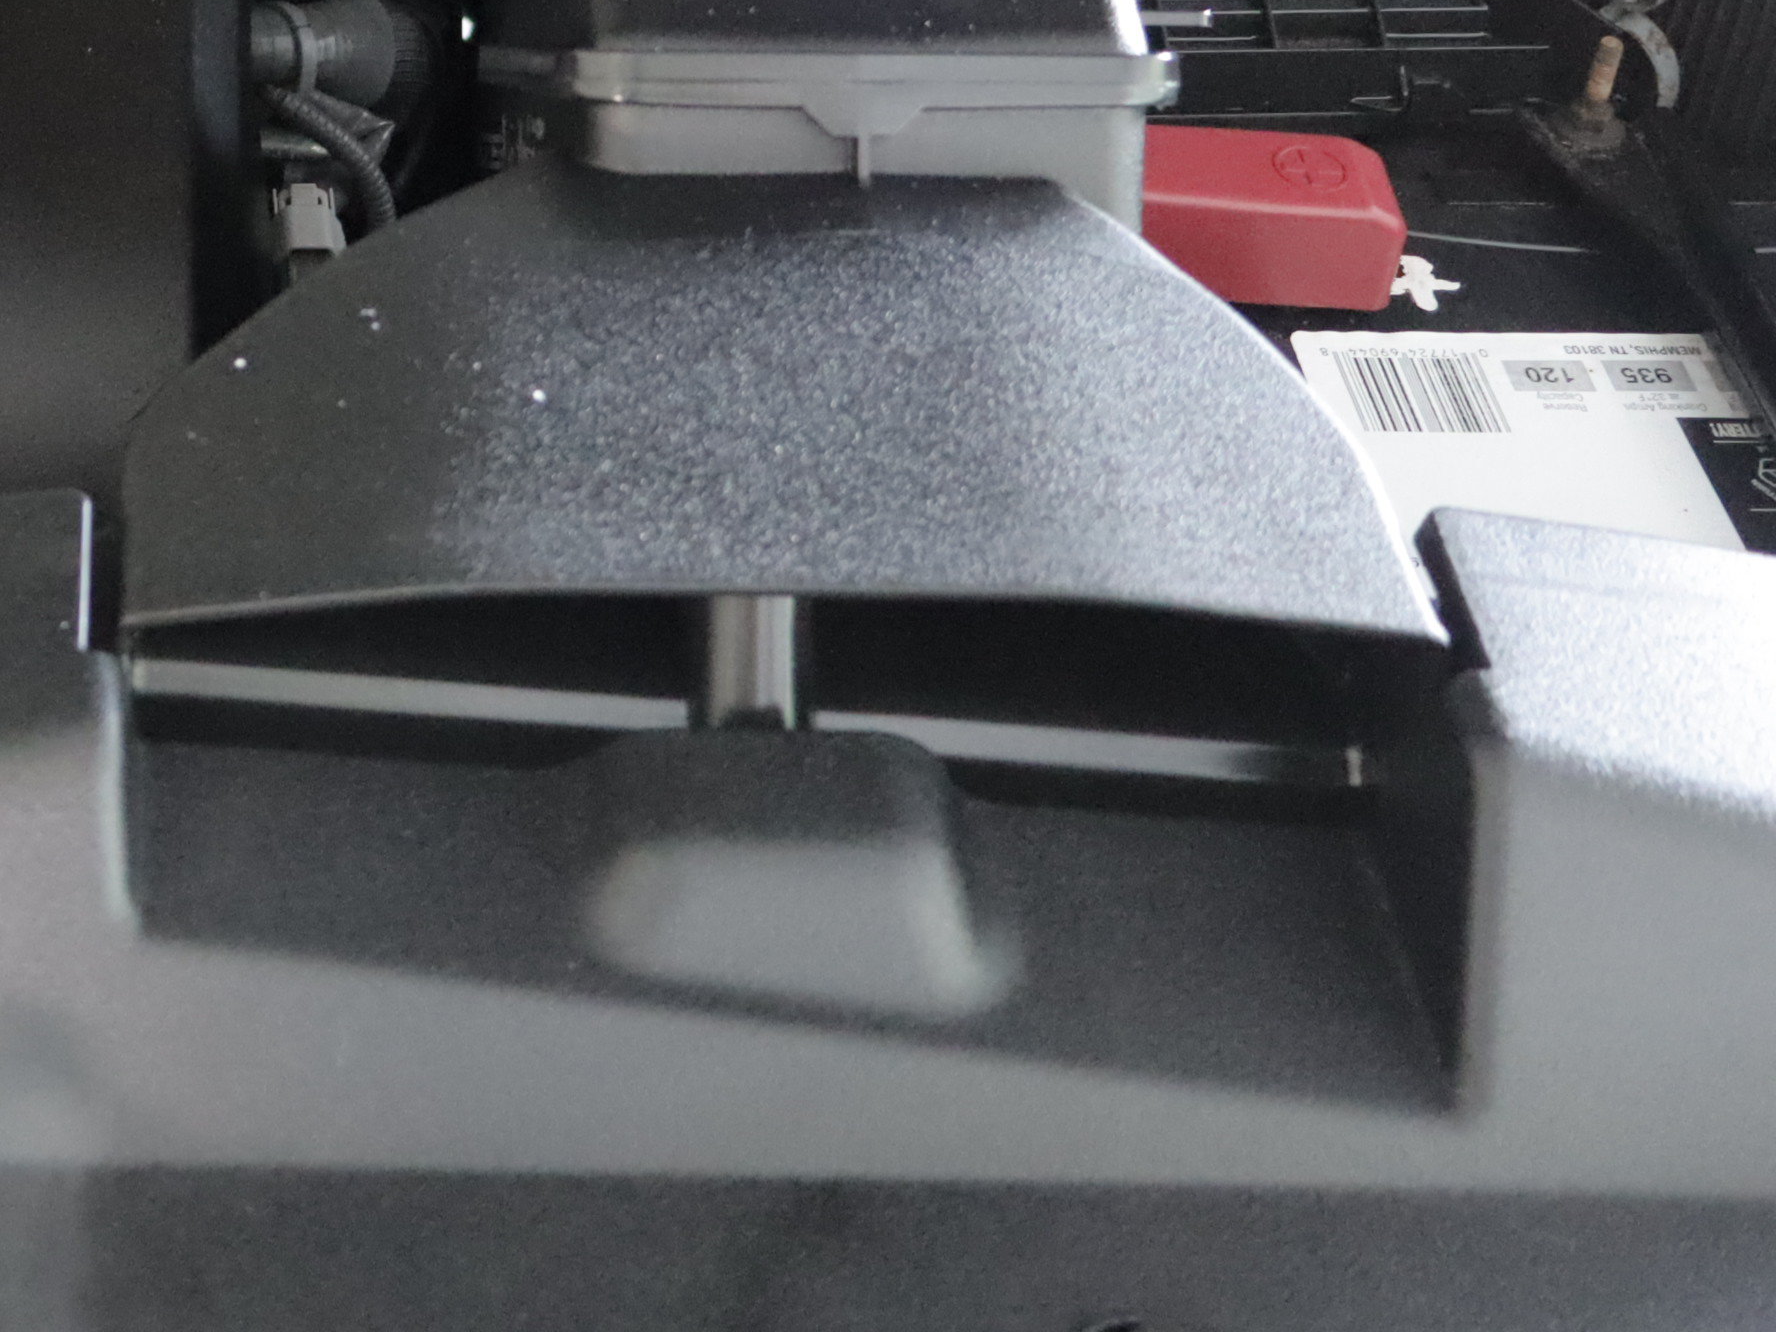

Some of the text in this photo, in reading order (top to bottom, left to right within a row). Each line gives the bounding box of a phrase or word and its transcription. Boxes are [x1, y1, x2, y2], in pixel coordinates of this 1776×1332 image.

[1563, 344, 1702, 356] MEMPHIS, TN 38103
[1524, 367, 1574, 384] 120
[1621, 367, 1673, 384] 935
[1543, 402, 1589, 413] Reserve
